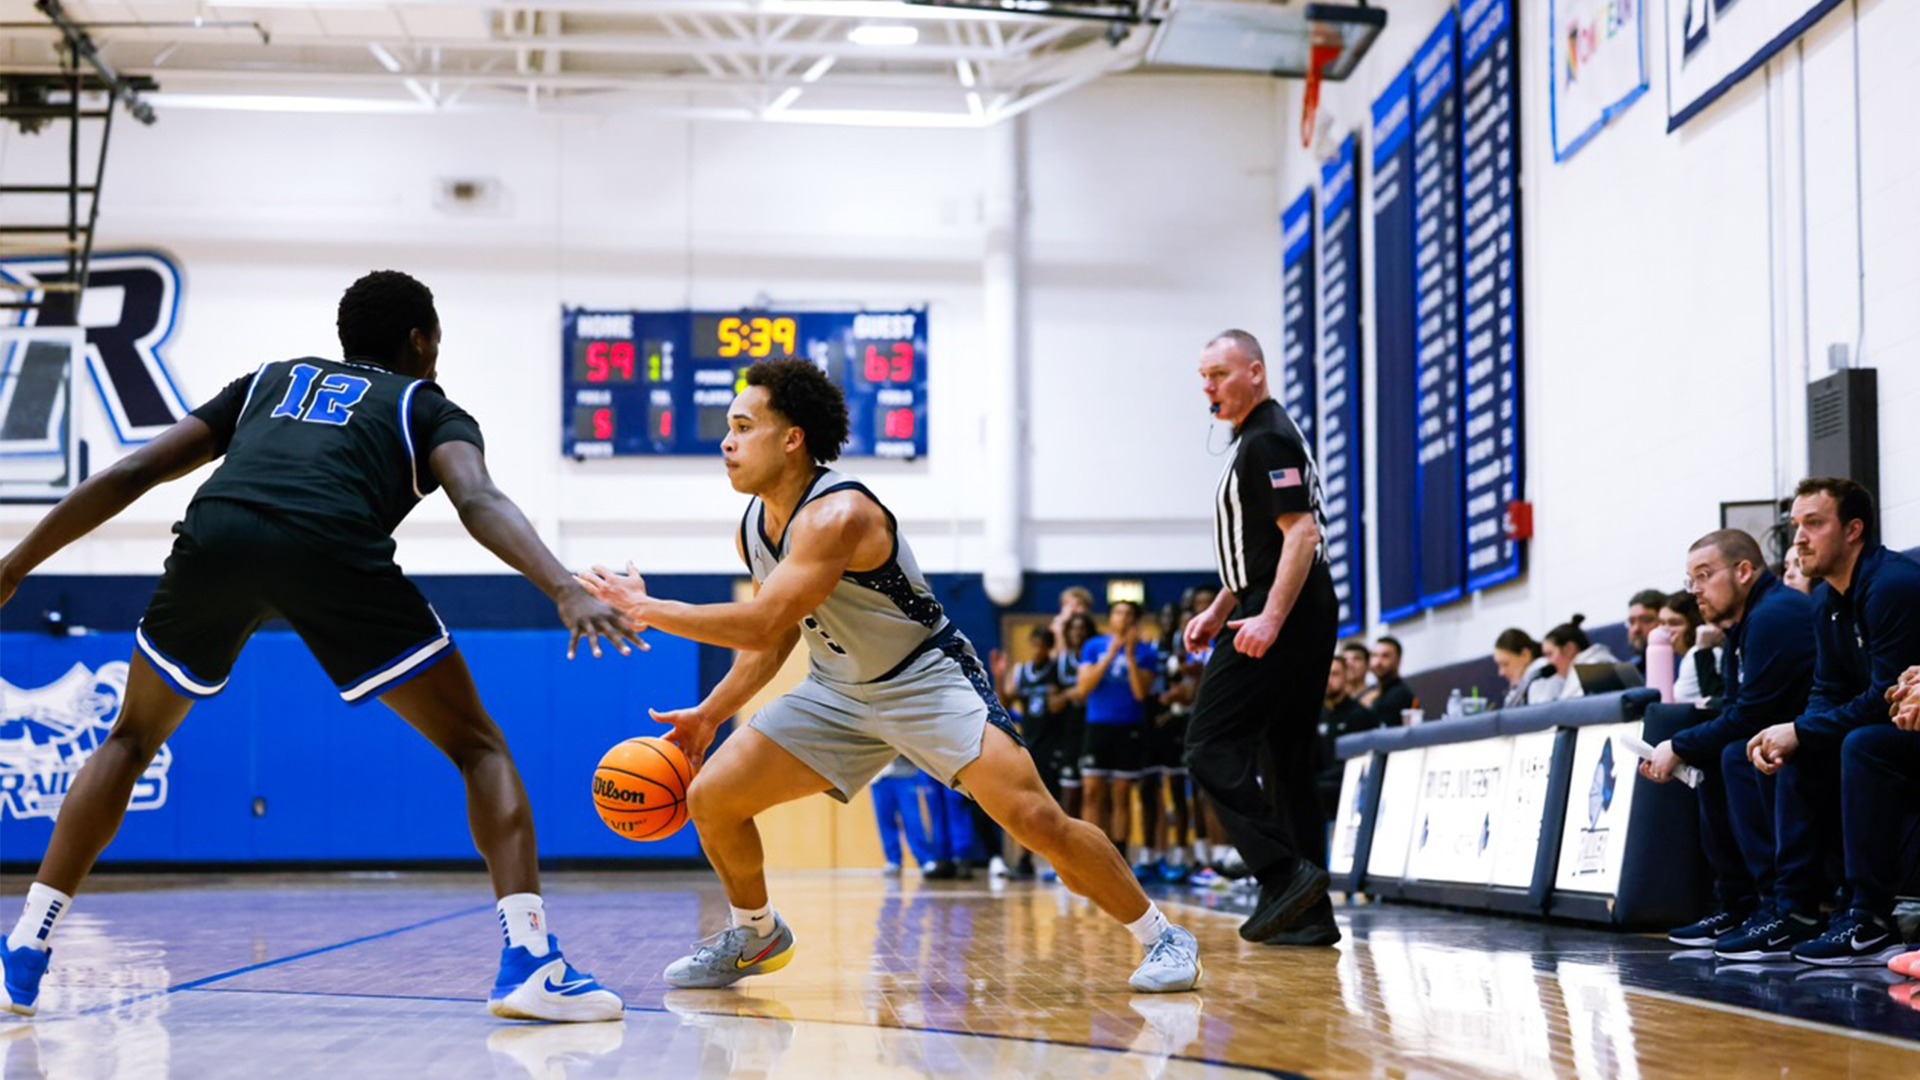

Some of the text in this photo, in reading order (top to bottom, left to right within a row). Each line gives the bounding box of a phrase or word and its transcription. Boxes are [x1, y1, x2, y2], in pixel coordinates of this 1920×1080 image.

[718, 317, 796, 358] 5:39
[586, 341, 635, 382] 59
[865, 342, 914, 383] 63
[270, 363, 372, 425] 12
[593, 408, 613, 440] 5
[660, 411, 672, 437] 1
[0, 768, 168, 821] RAIS
